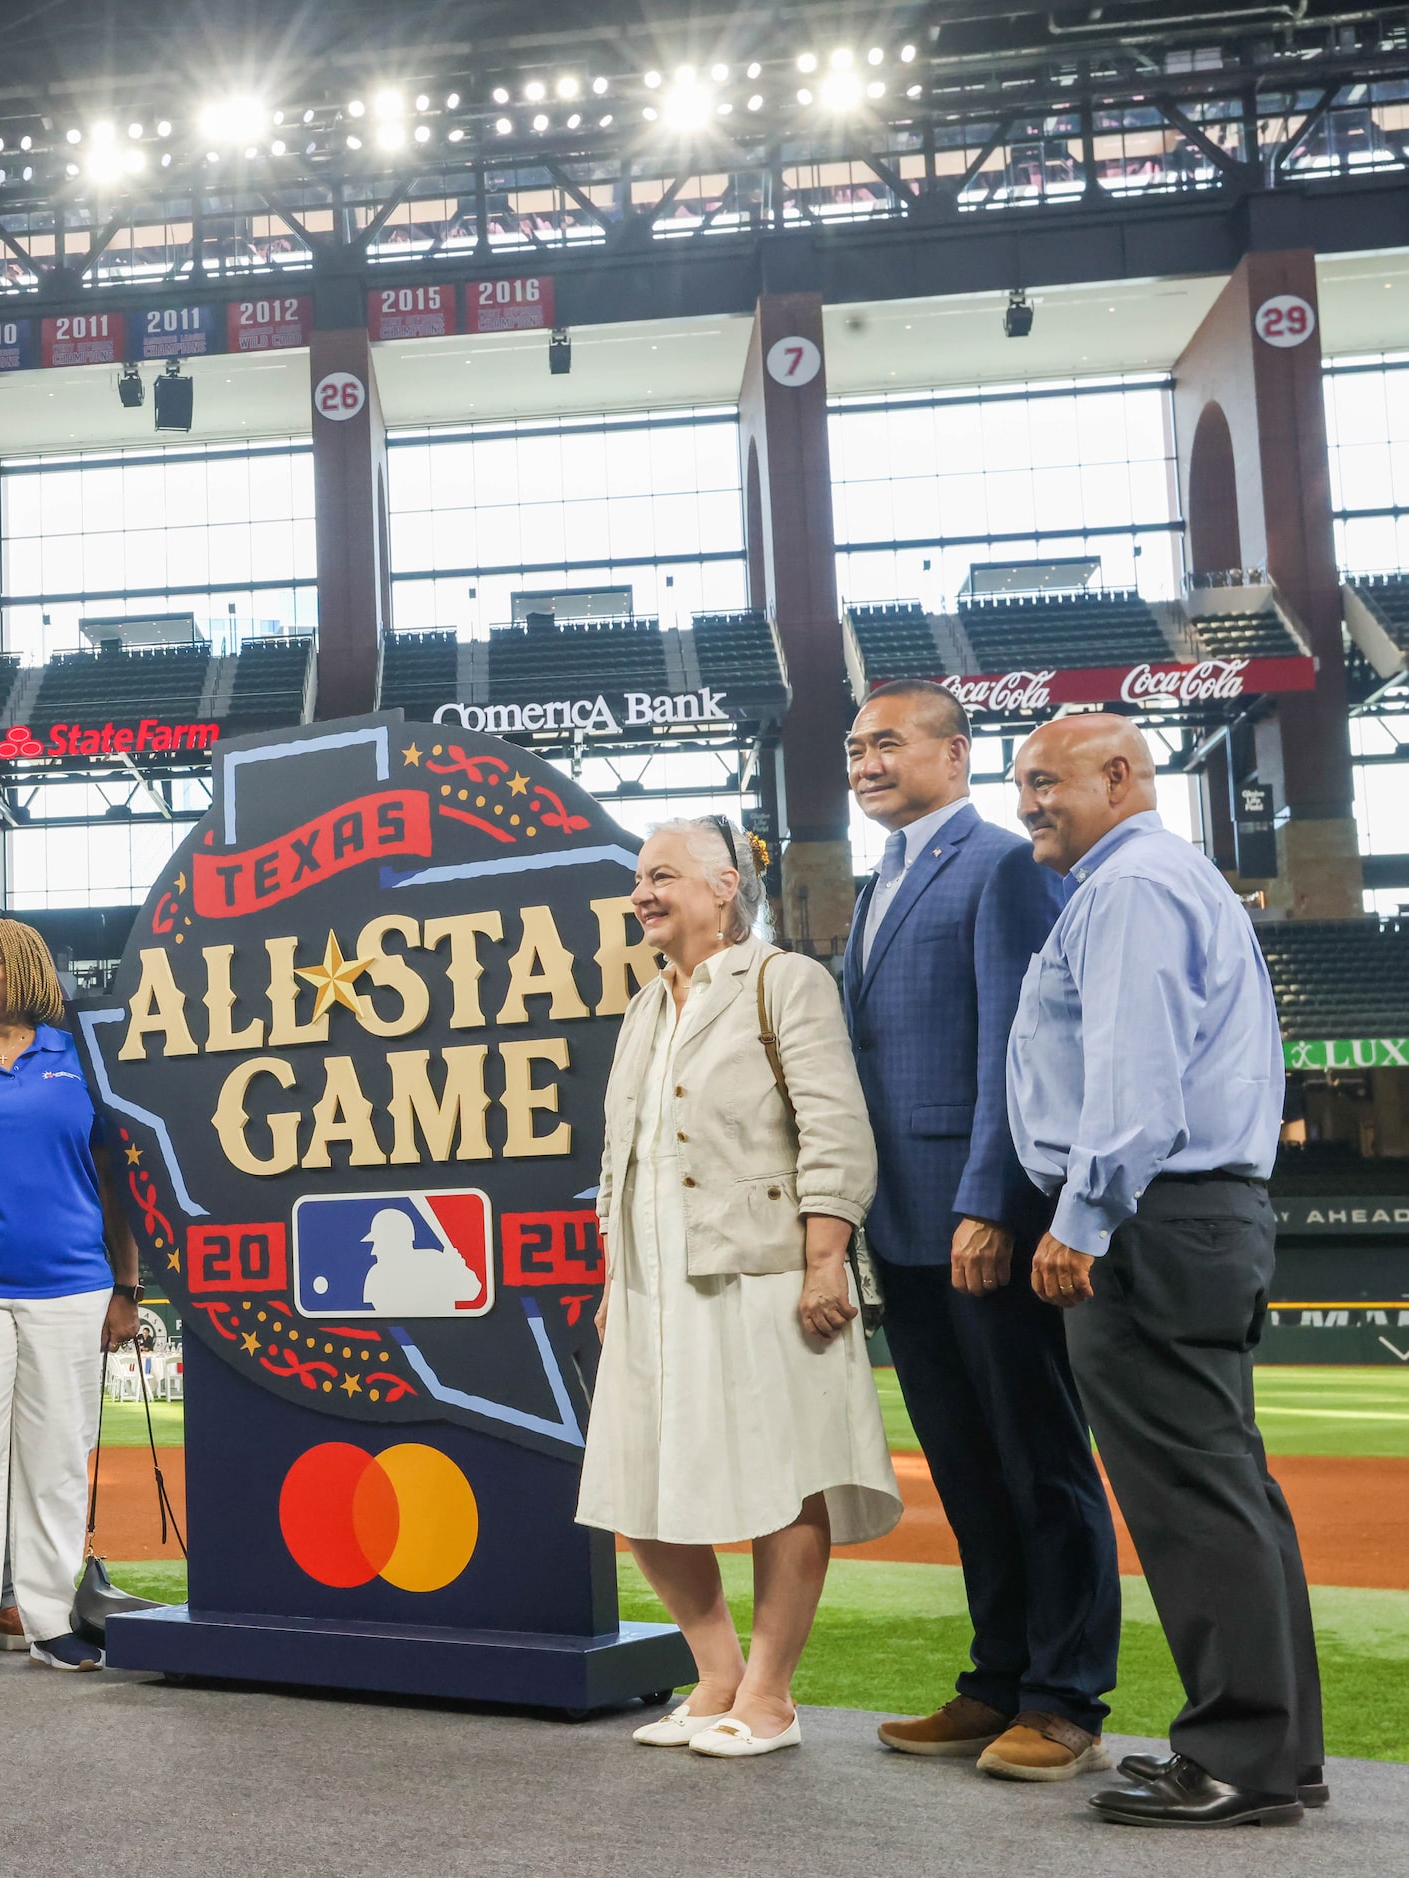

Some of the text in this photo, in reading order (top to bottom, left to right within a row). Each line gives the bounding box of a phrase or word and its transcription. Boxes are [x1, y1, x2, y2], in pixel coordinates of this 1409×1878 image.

[381, 286, 440, 313] 2015
[478, 278, 540, 305] 2016
[56, 314, 108, 340] 2011
[147, 307, 200, 333] 2011
[240, 299, 299, 325] 2012
[1262, 305, 1308, 339] 29
[784, 346, 804, 377] 7
[320, 382, 359, 411] 26
[940, 669, 1056, 712] Coca-Cola
[1120, 658, 1250, 704] Coca-Cola
[623, 687, 730, 726] Bank
[215, 801, 405, 908] TEXAS
[210, 1037, 572, 1177] GAME
[1306, 1208, 1409, 1224] AHEAD
[202, 1221, 603, 1282] 20 24
